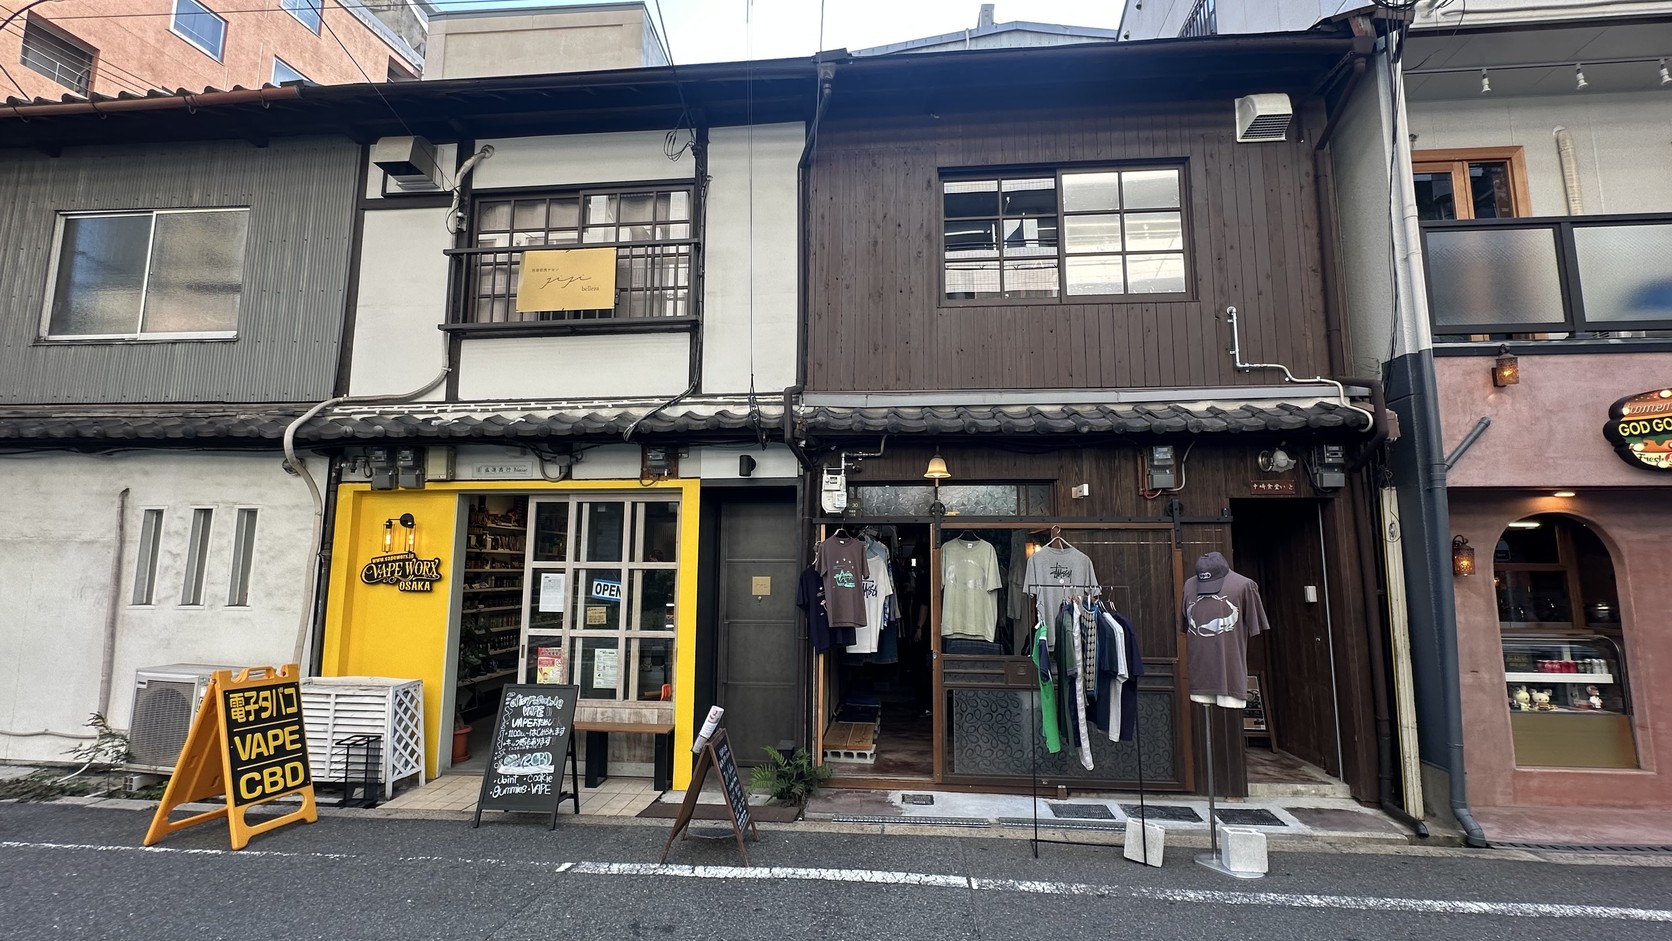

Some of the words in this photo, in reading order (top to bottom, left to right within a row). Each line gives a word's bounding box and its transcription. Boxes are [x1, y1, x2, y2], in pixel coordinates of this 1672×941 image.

[1618, 421, 1651, 437] GOD
[361, 561, 403, 583] VAPE
[405, 558, 441, 580] WORX
[399, 581, 431, 591] OSAKA
[229, 687, 298, 723] 電子タバコ
[234, 725, 302, 761] VAPE
[239, 761, 305, 800] CBD
[531, 783, 551, 795] VAPE
